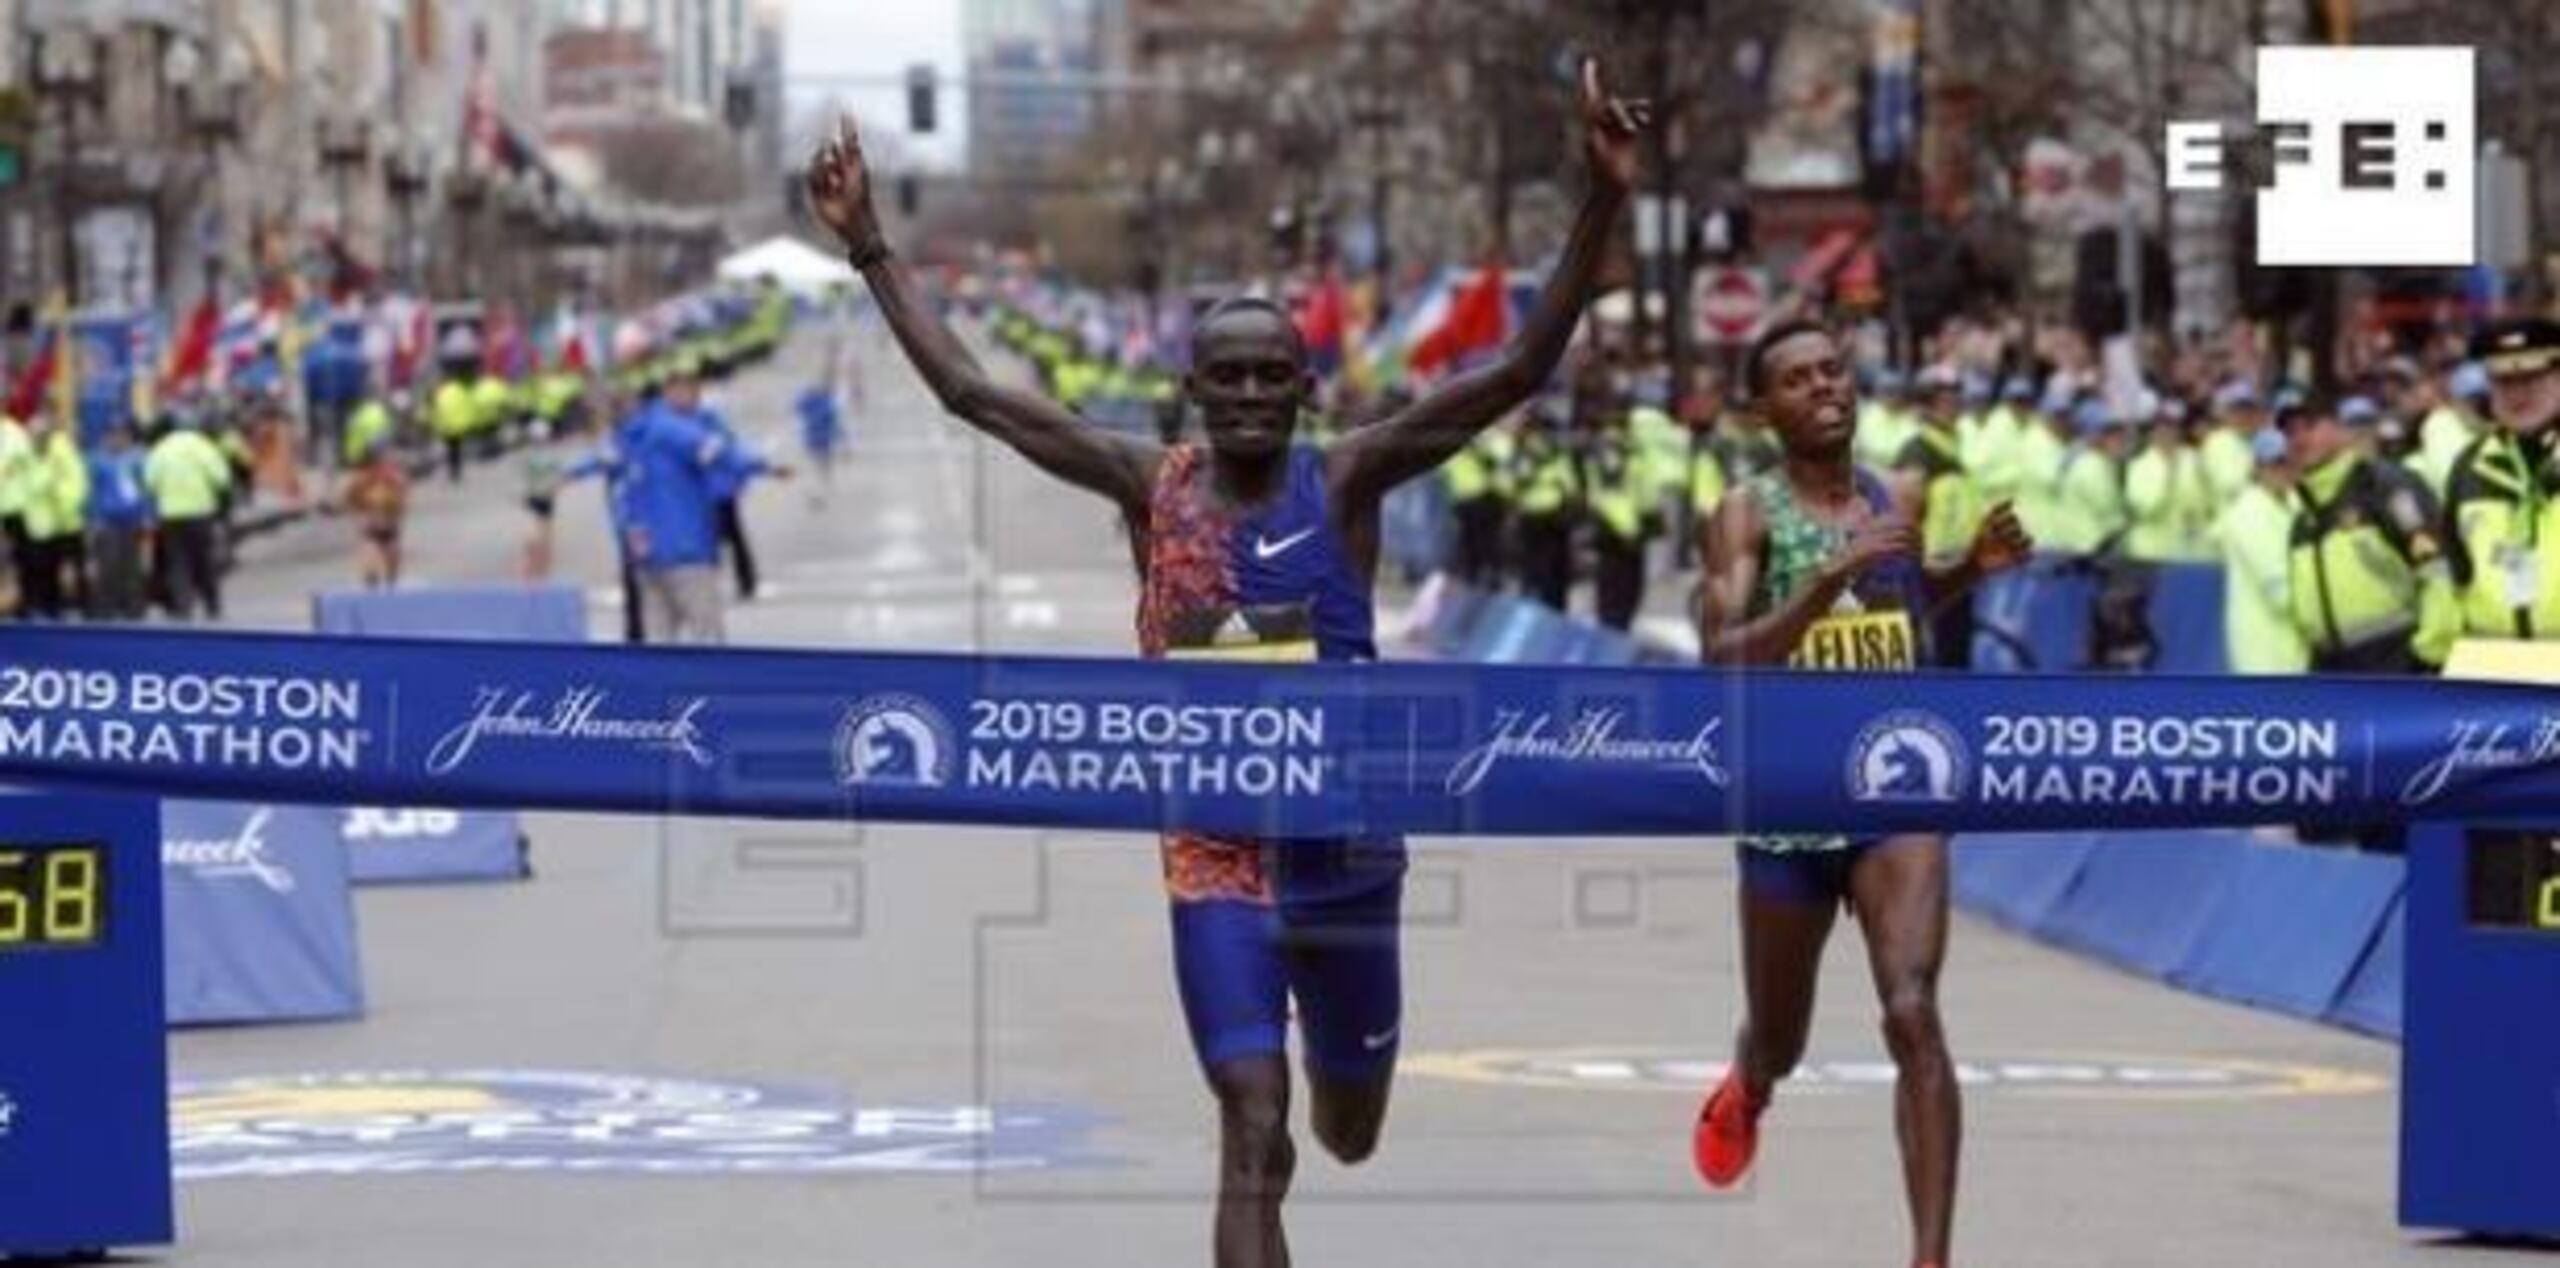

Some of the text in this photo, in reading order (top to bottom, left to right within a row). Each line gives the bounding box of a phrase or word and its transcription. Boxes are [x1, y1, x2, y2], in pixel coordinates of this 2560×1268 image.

[1797, 622, 1908, 670] ELISA
[0, 668, 359, 720] 2019 BOSTON
[0, 715, 358, 769] MARATHON
[426, 684, 713, 776] John Hancock
[969, 700, 1086, 742] 2019
[1099, 703, 1325, 746] BOSTON
[1982, 716, 2098, 757] 2019
[2110, 717, 2336, 760] BOSTON
[966, 750, 1325, 797] MARATHON
[1446, 704, 1729, 796] John Hancock
[2402, 720, 2520, 804] John
[1981, 765, 2334, 803] MARATHON
